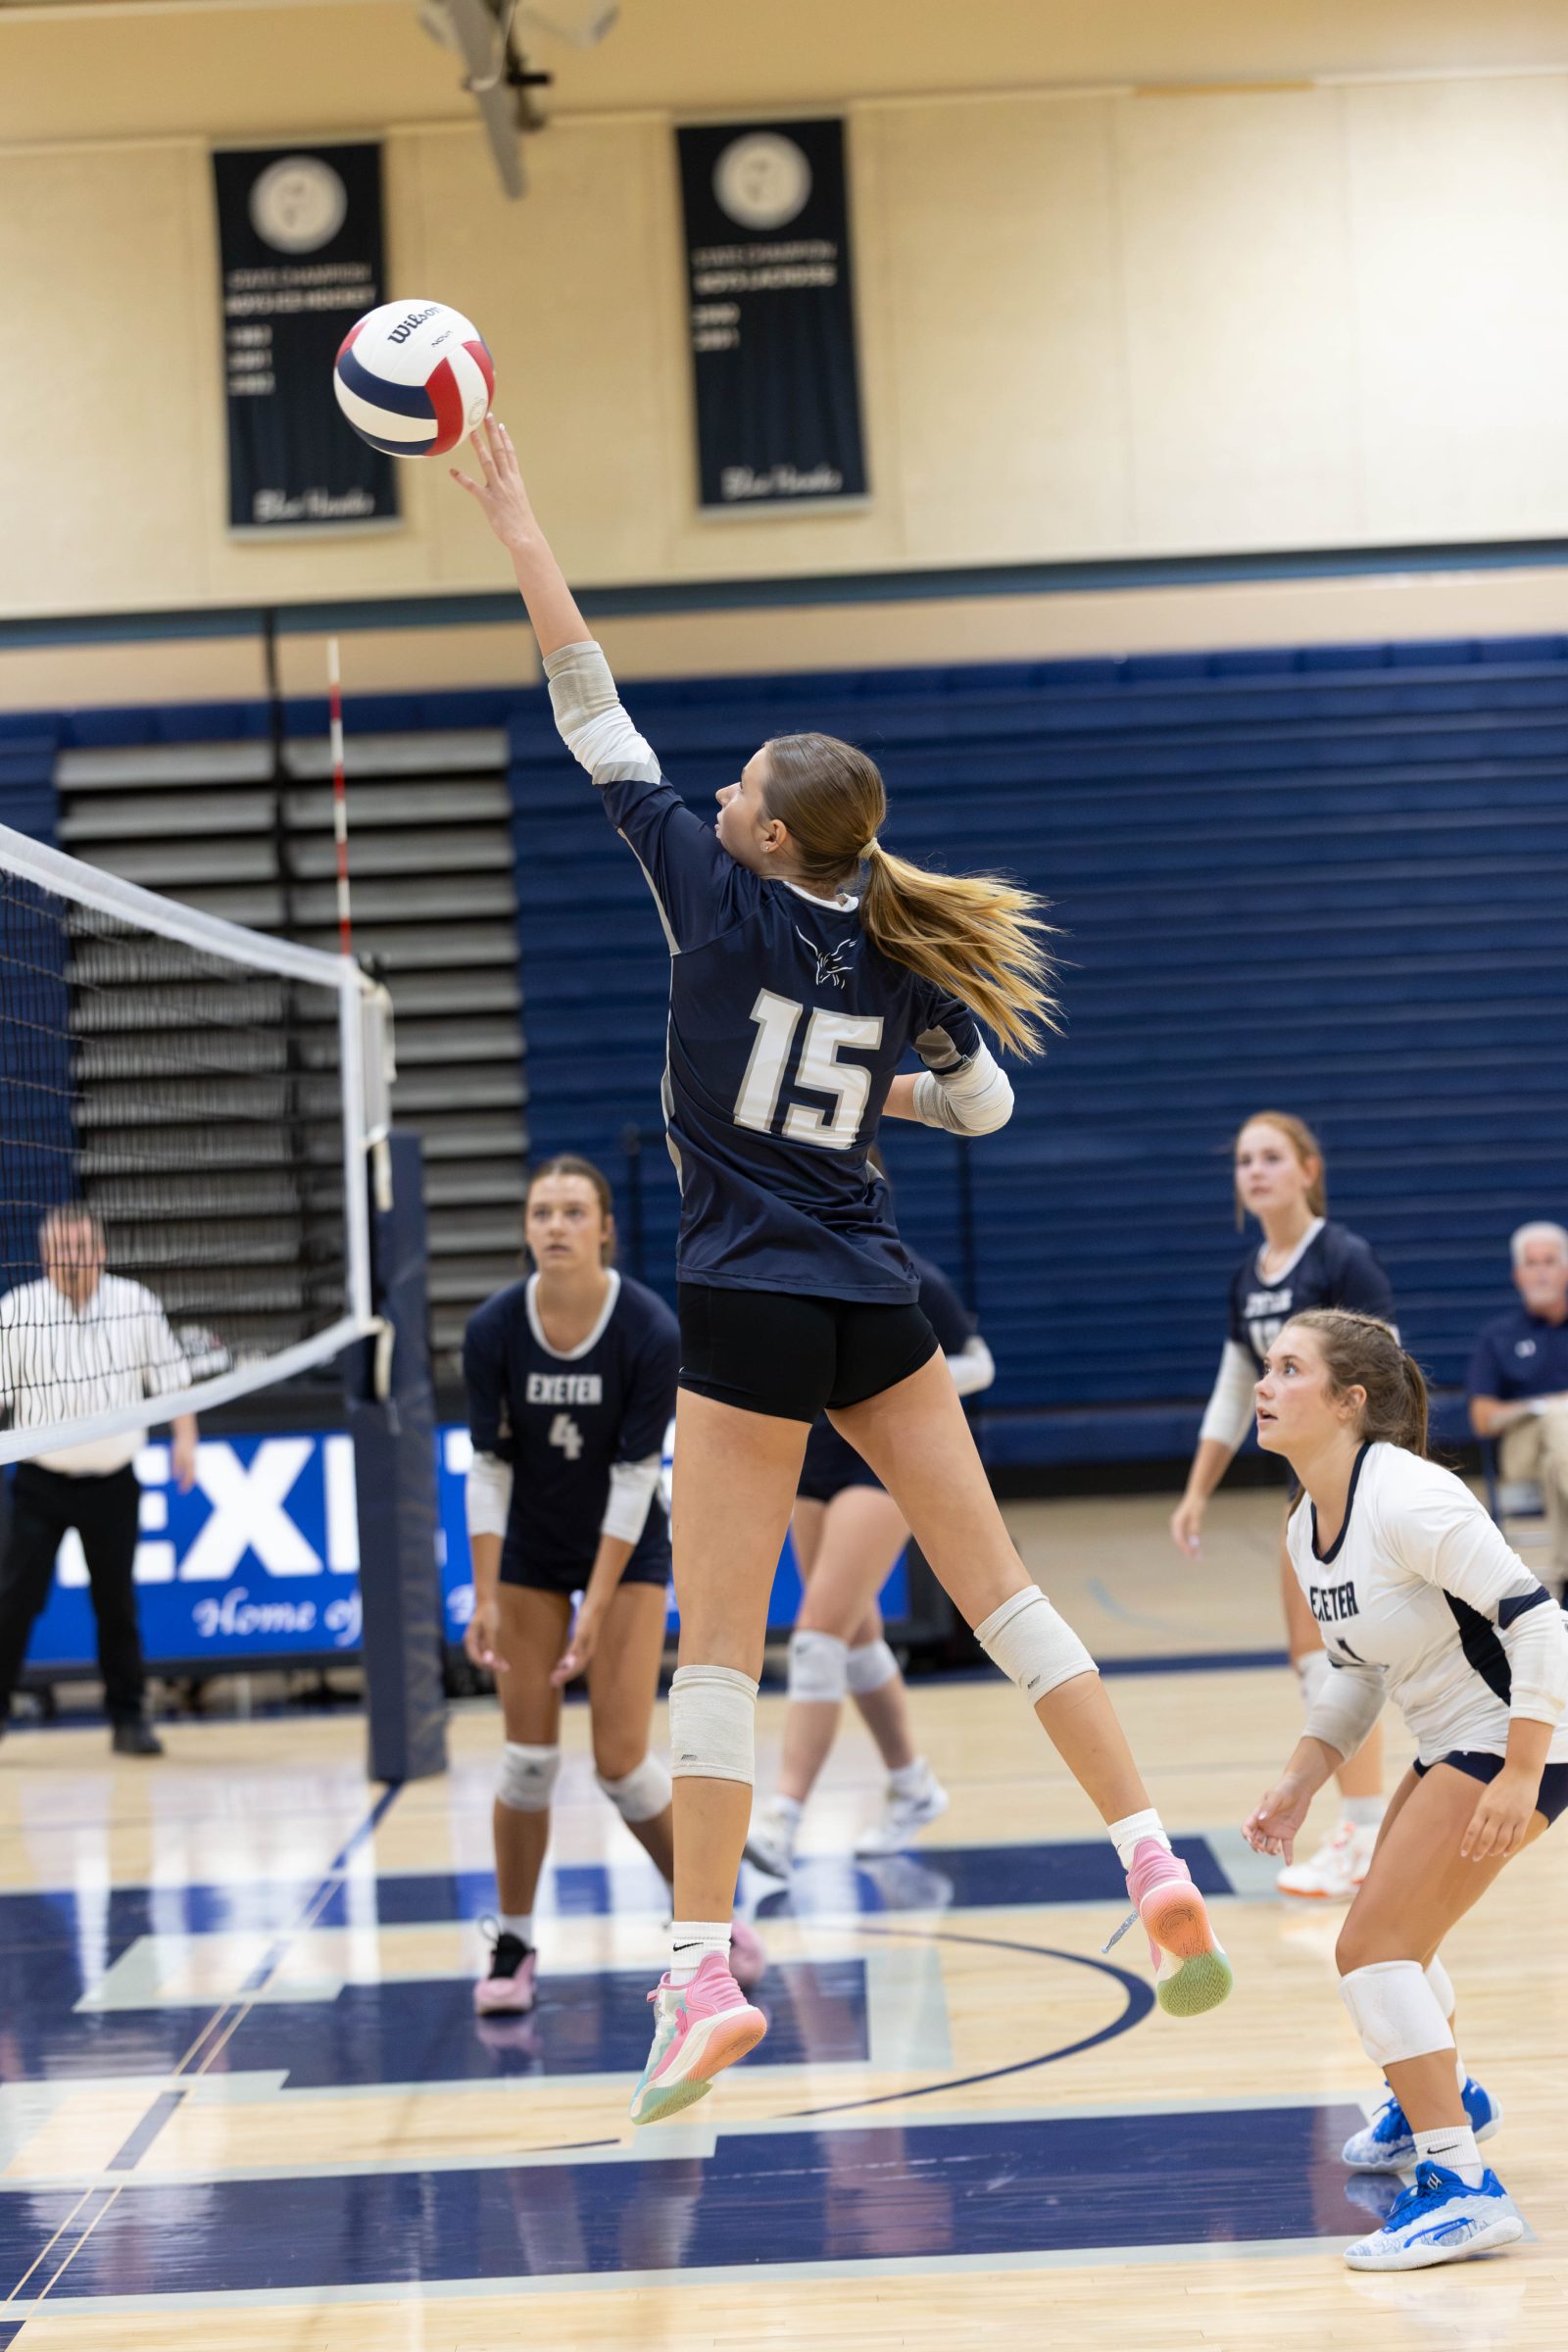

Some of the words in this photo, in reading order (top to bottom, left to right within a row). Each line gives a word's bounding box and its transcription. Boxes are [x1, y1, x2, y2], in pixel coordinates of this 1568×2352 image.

[387, 307, 441, 344] Wilson
[733, 988, 884, 1151] 15
[526, 1373, 603, 1404] EXETER
[549, 1412, 583, 1460] 4
[192, 1587, 317, 1638] Home
